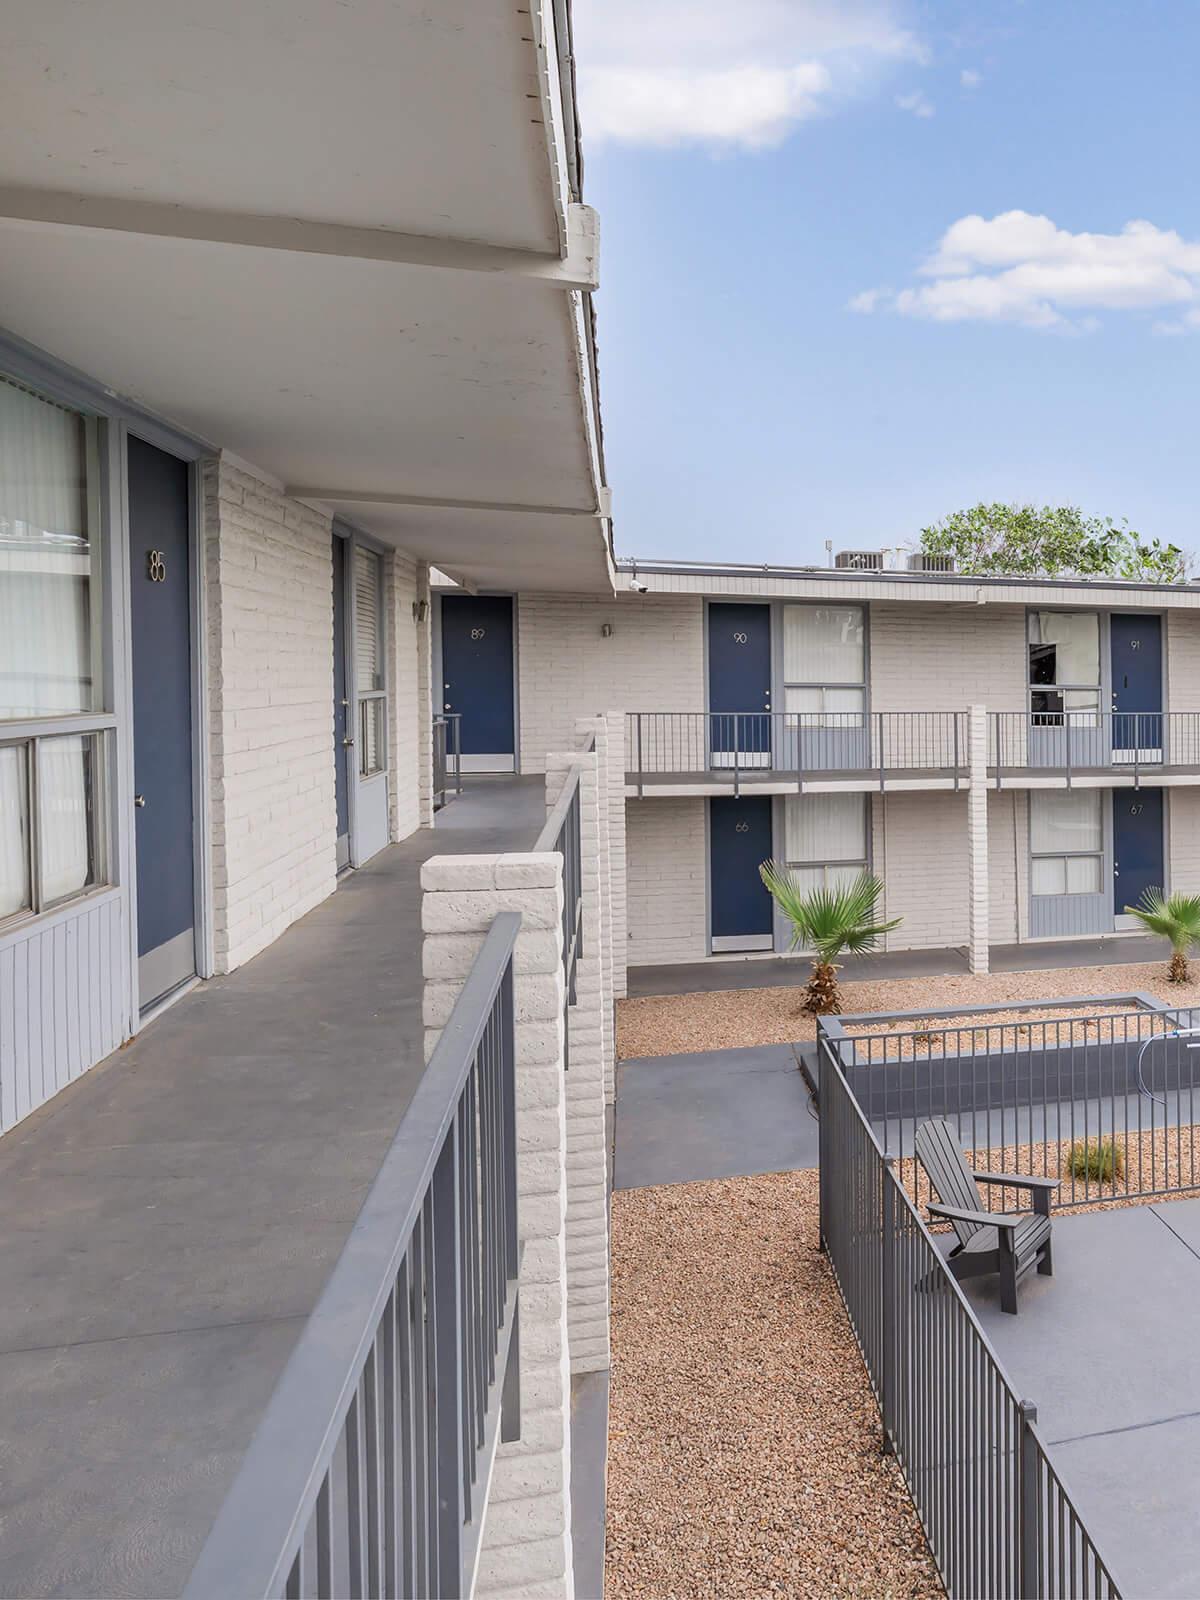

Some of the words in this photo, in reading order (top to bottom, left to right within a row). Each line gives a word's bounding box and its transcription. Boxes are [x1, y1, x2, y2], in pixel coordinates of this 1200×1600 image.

[149, 550, 166, 583] 85
[471, 628, 486, 641] 89
[734, 632, 747, 644] 90
[1131, 640, 1141, 650] 91
[1130, 805, 1143, 816] 67
[735, 823, 749, 833] 66
